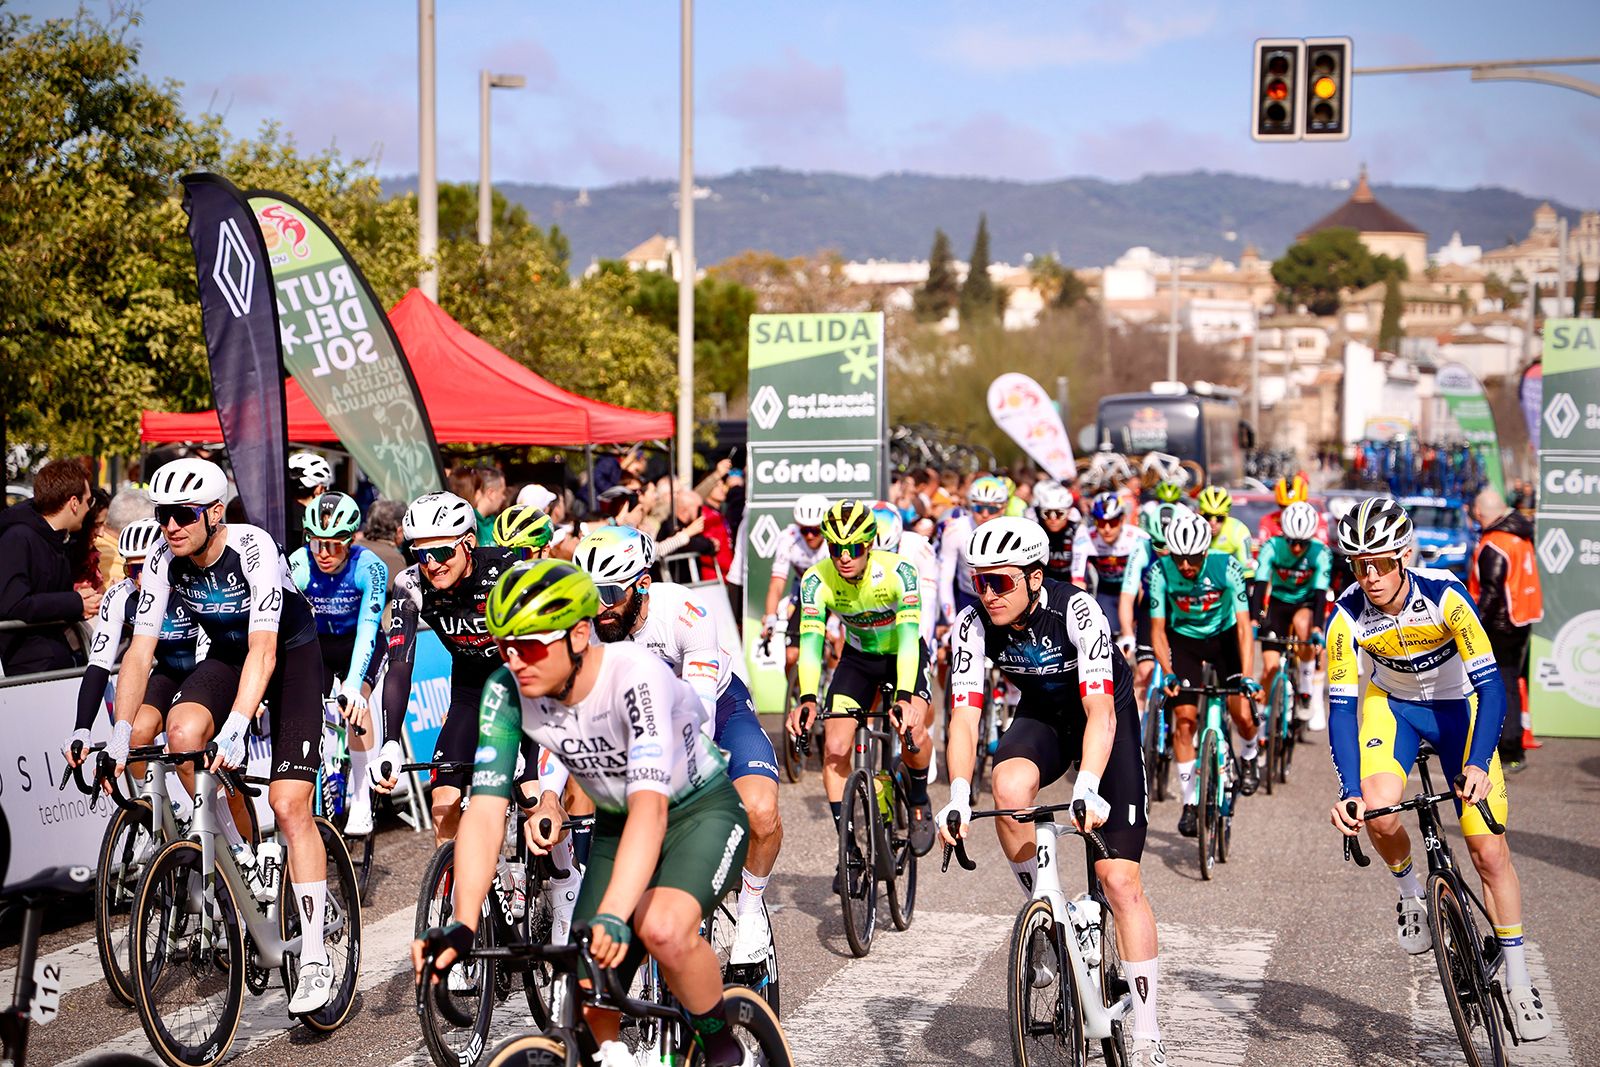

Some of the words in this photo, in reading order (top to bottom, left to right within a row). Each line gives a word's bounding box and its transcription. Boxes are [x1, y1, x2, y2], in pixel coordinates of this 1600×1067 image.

[756, 318, 871, 344] SALIDA
[1552, 326, 1600, 351] SA
[755, 457, 871, 483] Córdoba
[1545, 468, 1600, 495] Cór
[1580, 538, 1600, 553] Re
[245, 544, 260, 574] UBS
[186, 588, 208, 600] UBS
[221, 582, 245, 593] SCOTT
[440, 616, 488, 635] UAE
[1071, 597, 1093, 631] UBS
[1366, 621, 1395, 637] baloise
[1395, 632, 1419, 641] Team
[1398, 636, 1445, 648] Flanders
[1460, 627, 1475, 656] Flanders
[1009, 655, 1031, 663] UBS
[1039, 646, 1063, 656] SCOTT
[1335, 633, 1344, 661] Flanders
[1477, 667, 1498, 678] baloise
[407, 675, 454, 733] SHIM
[480, 682, 508, 737] ALEA
[624, 687, 645, 740] RGA
[637, 682, 658, 738] SEGUROS
[561, 736, 616, 755] CAJA
[264, 857, 273, 888] GARMN
[492, 874, 514, 926] NAGO
[39, 963, 61, 1017] 112
